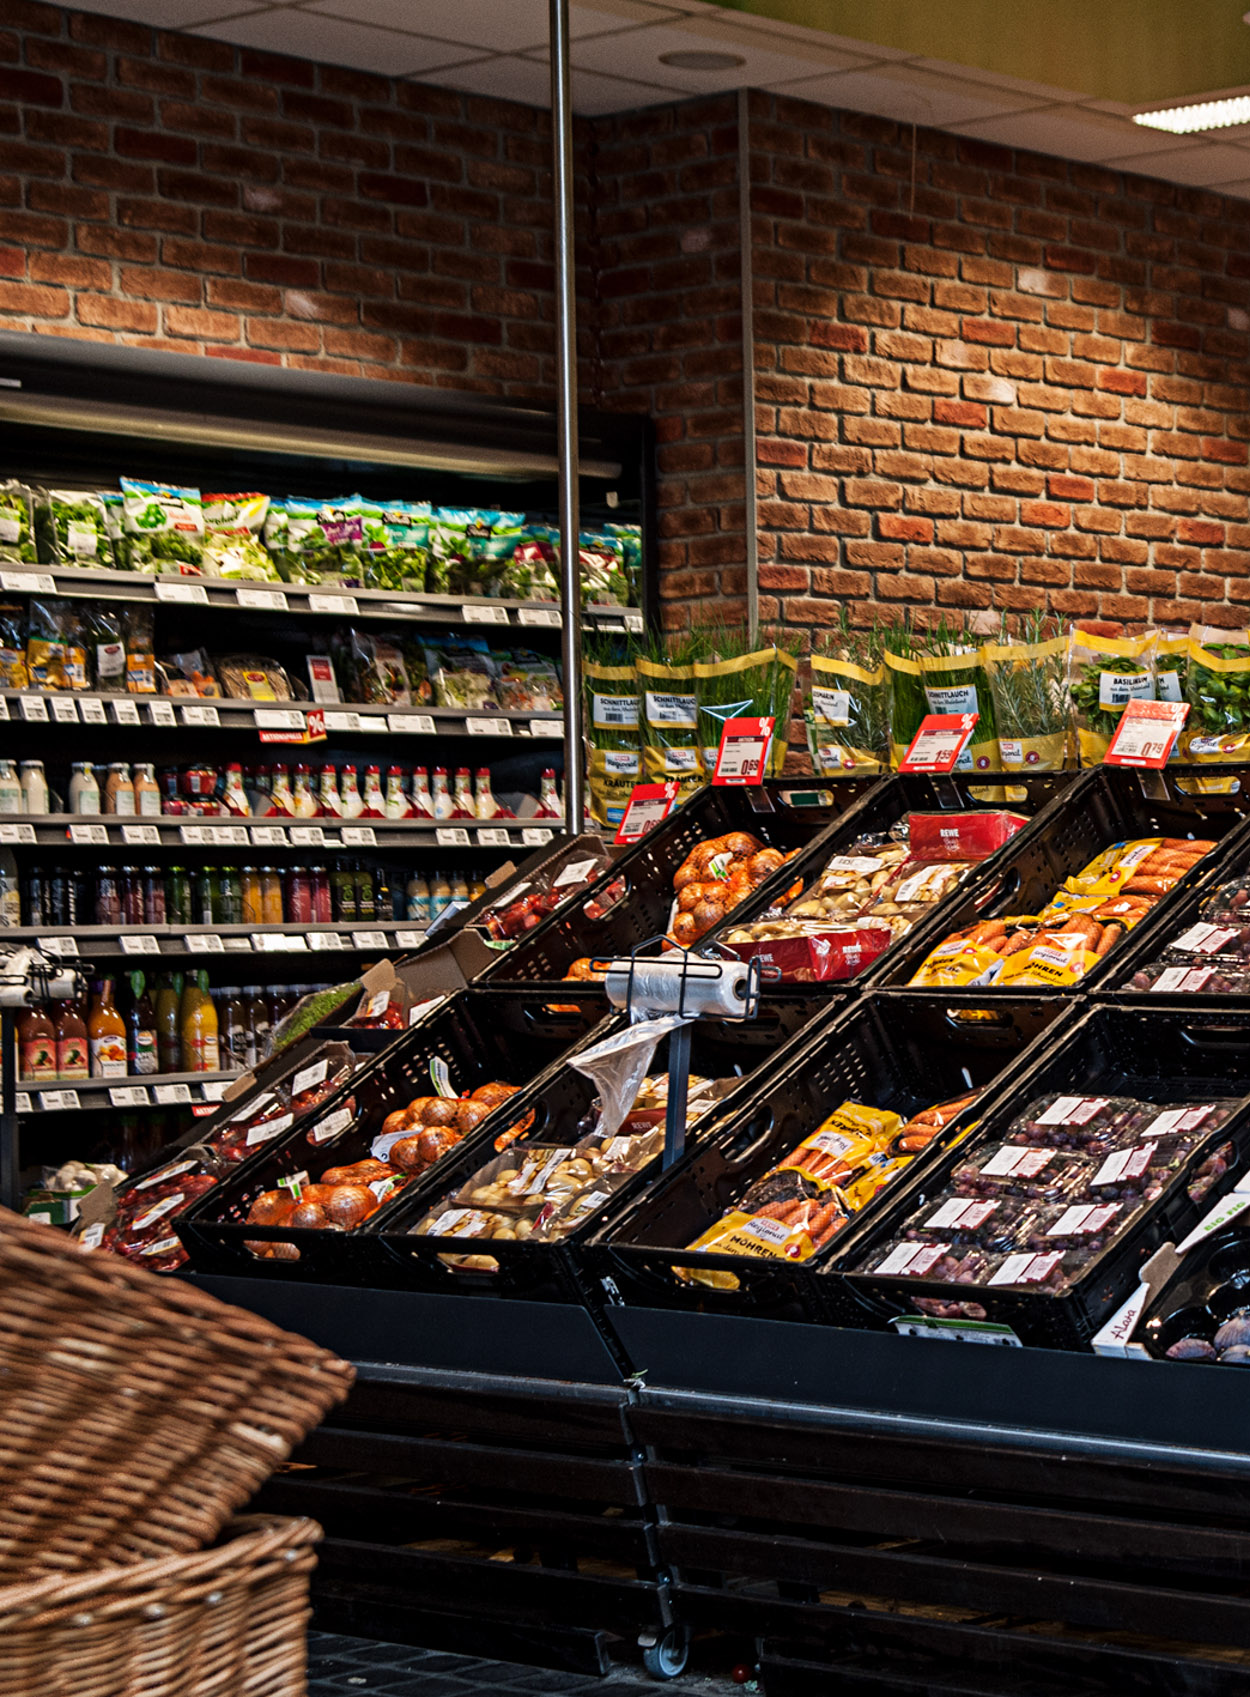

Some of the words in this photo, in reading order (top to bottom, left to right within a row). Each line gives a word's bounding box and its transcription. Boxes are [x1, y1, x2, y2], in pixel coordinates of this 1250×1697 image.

[1113, 676, 1148, 685] BASILIKUM
[928, 690, 969, 699] SCHNITTLAUCH
[940, 828, 959, 838] REWE
[1203, 1217, 1225, 1232] BIG
[1226, 1201, 1246, 1216] FIG
[747, 1221, 785, 1241] Regional
[730, 1235, 777, 1259] MÖHREN
[1110, 1308, 1137, 1340] Alara
